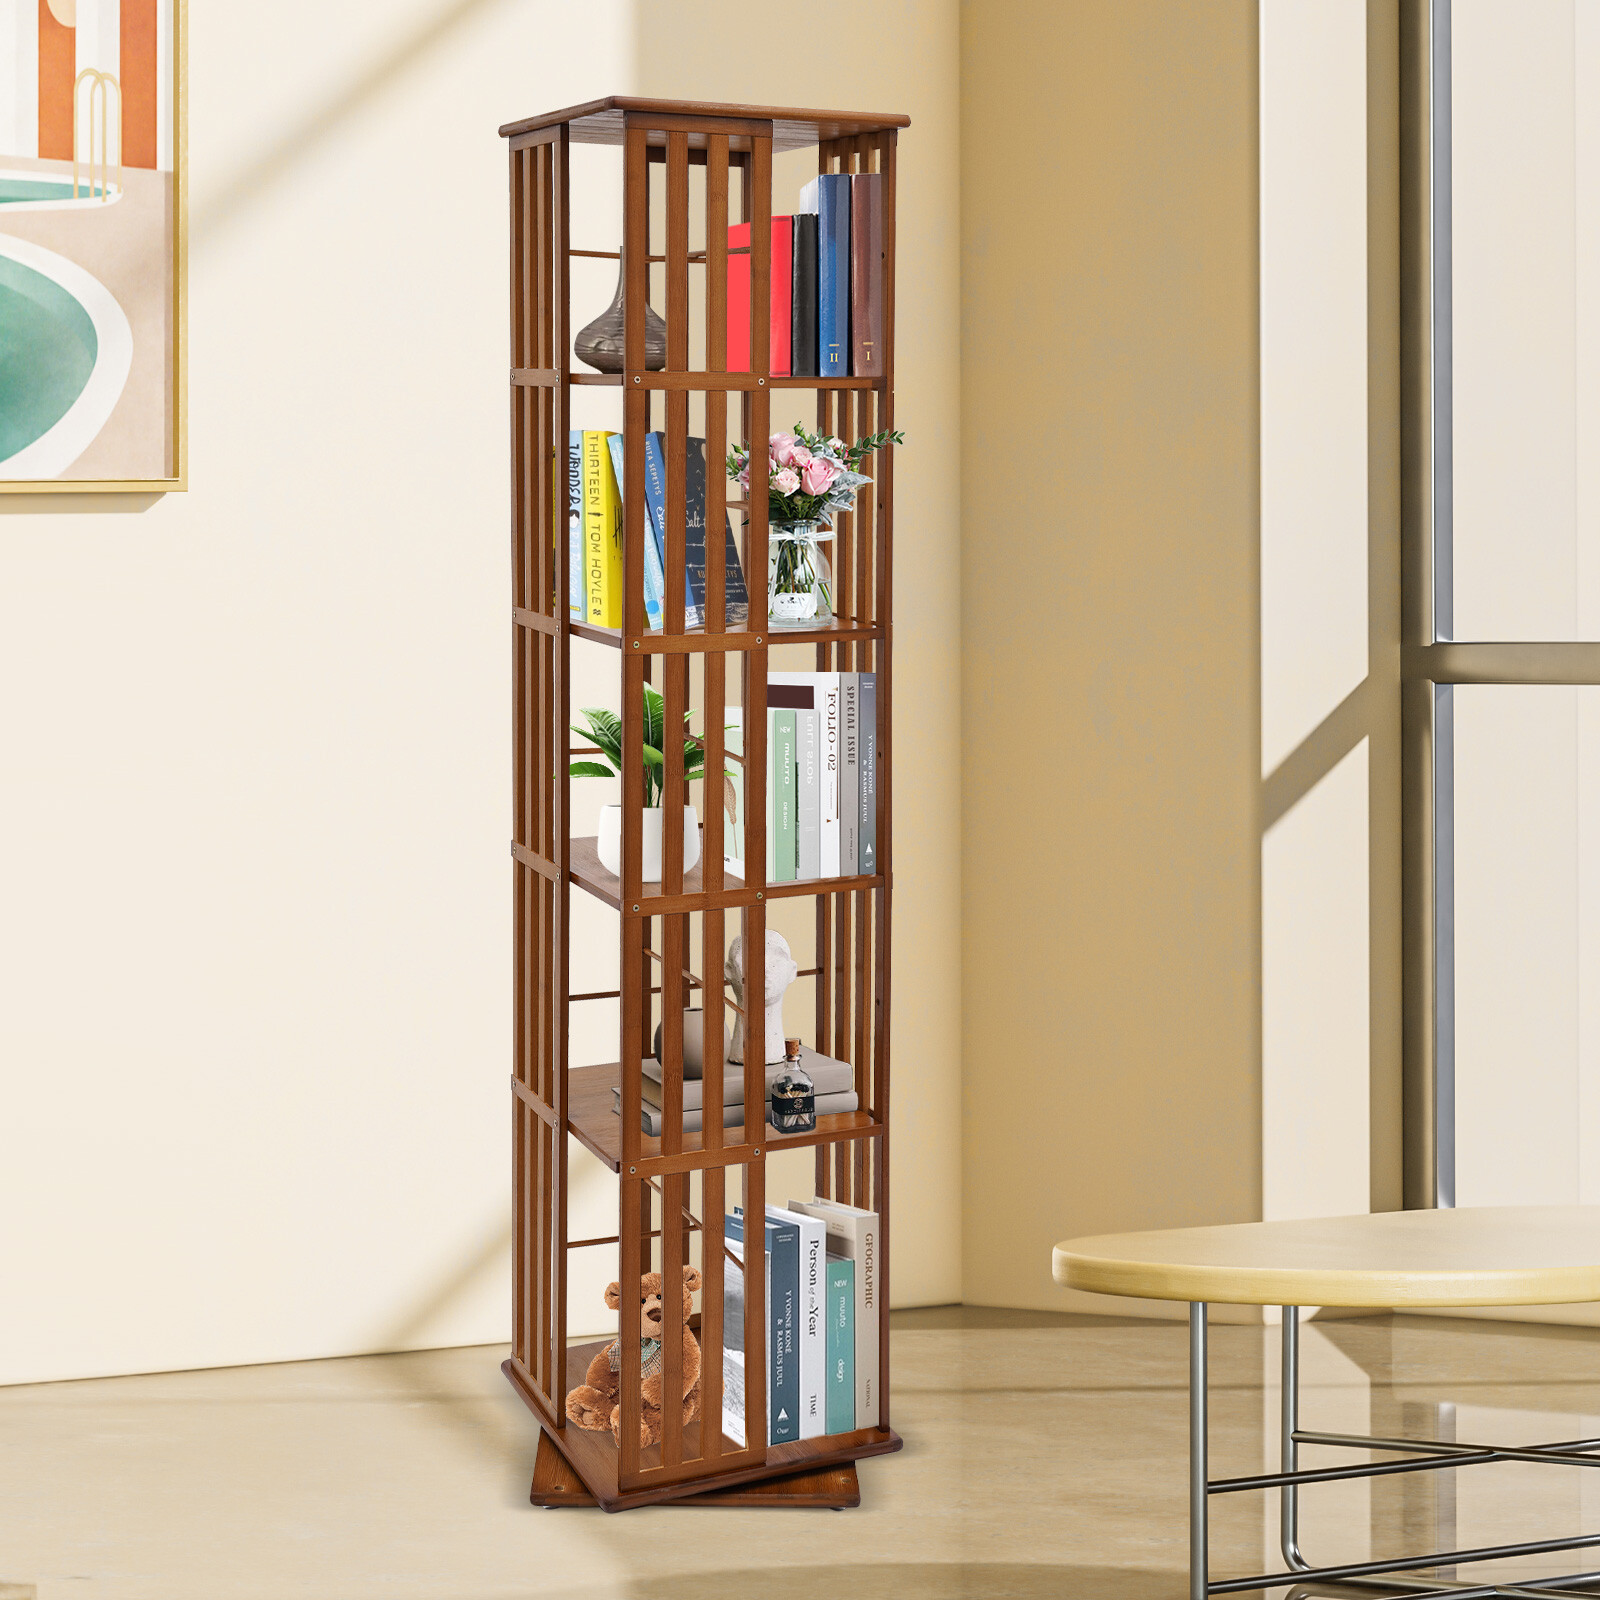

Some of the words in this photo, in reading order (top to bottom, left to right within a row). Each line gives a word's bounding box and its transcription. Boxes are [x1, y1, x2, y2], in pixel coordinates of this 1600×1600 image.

[829, 353, 838, 362] II
[866, 351, 871, 360] I
[589, 434, 601, 506] THIRTEEN
[648, 463, 662, 496] SEPETYS
[590, 525, 601, 553] TOM
[591, 558, 602, 605] HOYLE
[827, 693, 836, 743] FOLIO
[846, 686, 855, 731] SPECIAL
[827, 754, 836, 771] 02
[847, 736, 856, 766] ISSUE
[809, 1240, 819, 1286] Person
[777, 1318, 784, 1326] &
[808, 1306, 819, 1337] Year
[839, 1296, 847, 1327] muuto
[776, 1330, 784, 1365] RASMUS
[785, 1329, 793, 1354] KONÉ
